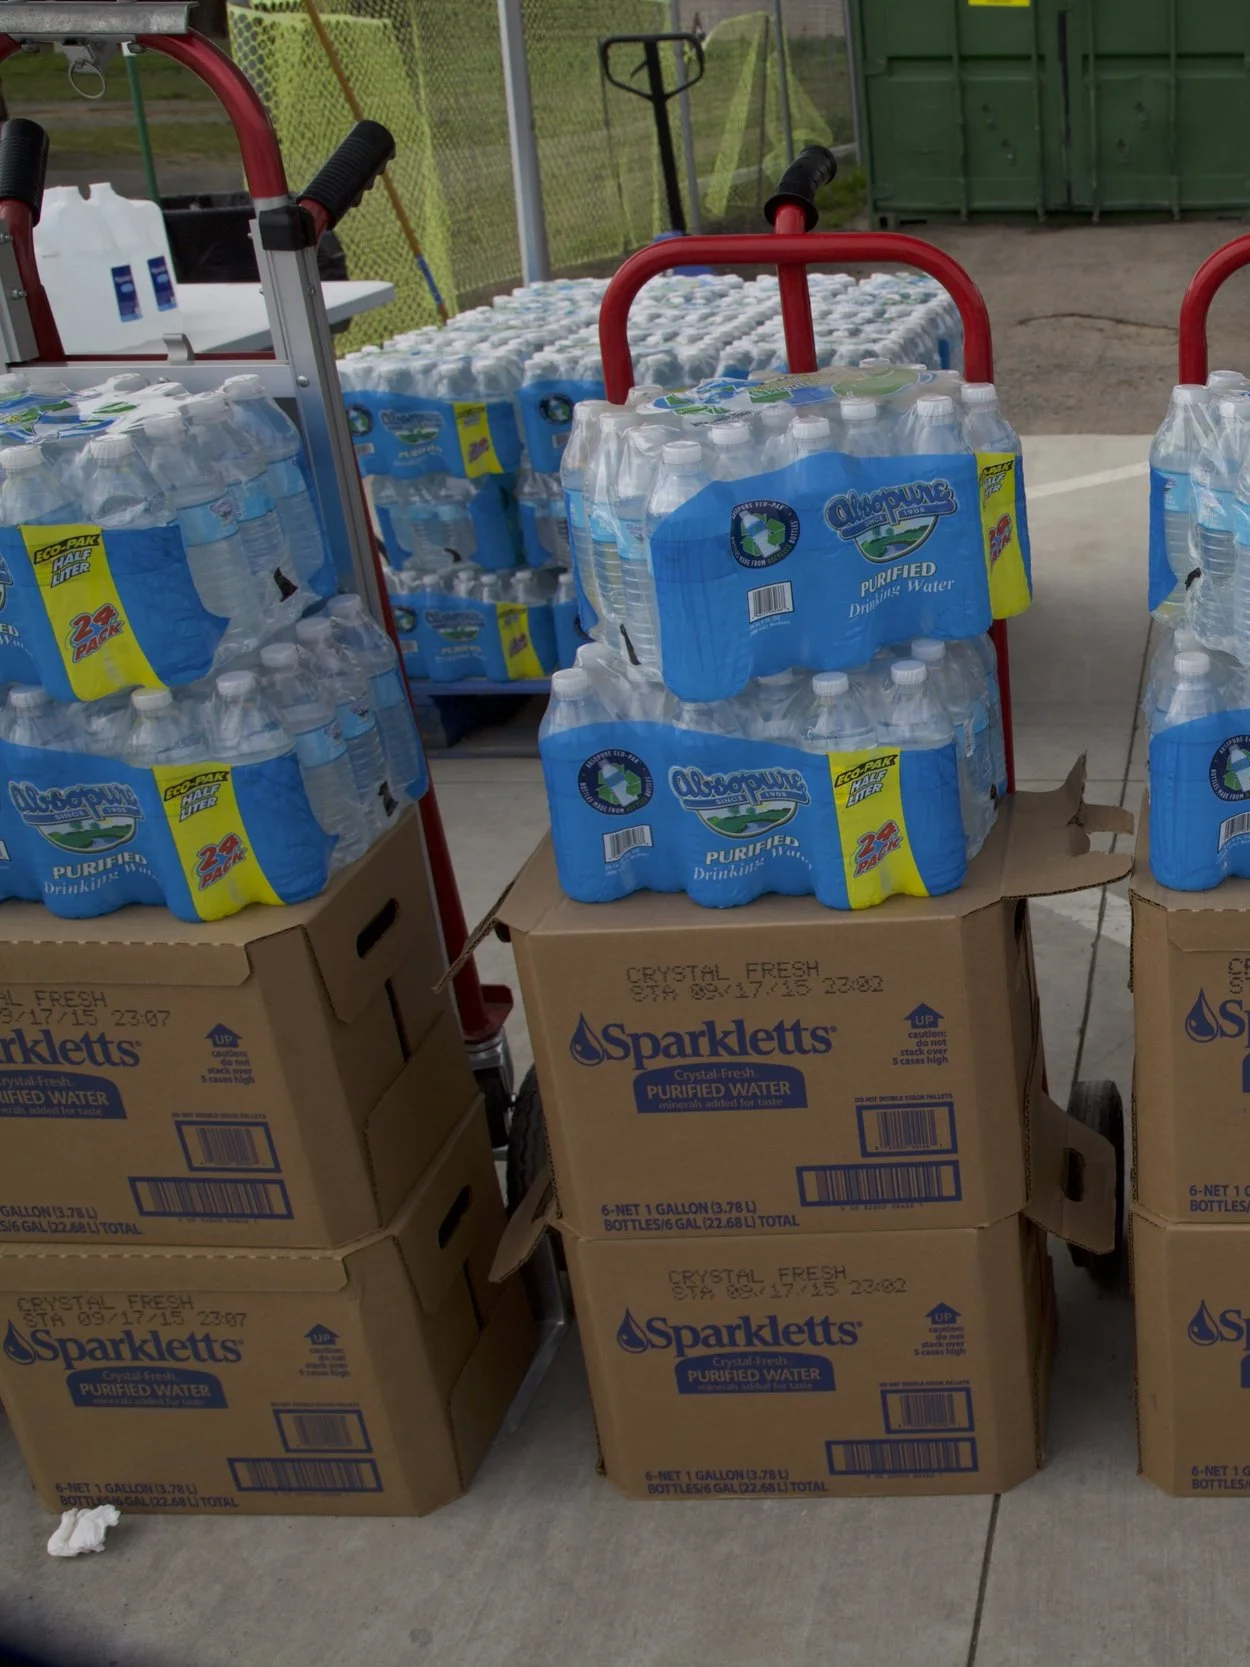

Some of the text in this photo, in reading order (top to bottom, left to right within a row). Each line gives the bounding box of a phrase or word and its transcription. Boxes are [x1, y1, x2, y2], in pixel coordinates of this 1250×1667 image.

[864, 506, 926, 527] SINCE 1908
[34, 534, 100, 564] ECO-PAK
[51, 548, 92, 572] HALF
[50, 562, 90, 587] LITER
[860, 561, 937, 597] PURIFIED
[848, 577, 955, 619] Drinking Water
[72, 603, 118, 642] 24
[72, 620, 125, 662] PACK
[834, 754, 898, 788] ECO-PAK
[850, 770, 888, 792] HALF
[163, 771, 230, 800] ECO-PAK
[181, 783, 220, 808] HALF
[846, 783, 884, 808] LITER
[179, 795, 217, 821] LITER
[716, 794, 742, 805] SINCE
[198, 832, 241, 869] 24
[706, 835, 800, 865] PURIFIED
[856, 820, 898, 859] 24
[53, 851, 148, 880] PURIFIED
[693, 856, 765, 882] Drinking
[854, 835, 903, 878] PACK
[199, 849, 247, 890] PACK
[627, 960, 820, 985] CRYSTAL FRESH
[34, 990, 108, 1008] FRESH
[603, 1018, 833, 1070] Sparkletts
[48, 1091, 109, 1106] WATER
[647, 1080, 791, 1100] PURIFIED WATER
[1189, 1185, 1229, 1197] 6-NET
[1233, 1185, 1239, 1197] 1
[656, 1202, 708, 1217] GALLON
[758, 1215, 799, 1229] TOTAL
[101, 1222, 141, 1234] TOTAL
[668, 1265, 846, 1285] CRYSTAL FRESH
[16, 1295, 194, 1312] CRYSTAL FRESH
[646, 1314, 858, 1358] Sparkletts
[34, 1330, 243, 1370] Sparkletts
[687, 1368, 820, 1384] PURIFIED WATER
[80, 1383, 211, 1397] PURIFIED WATER
